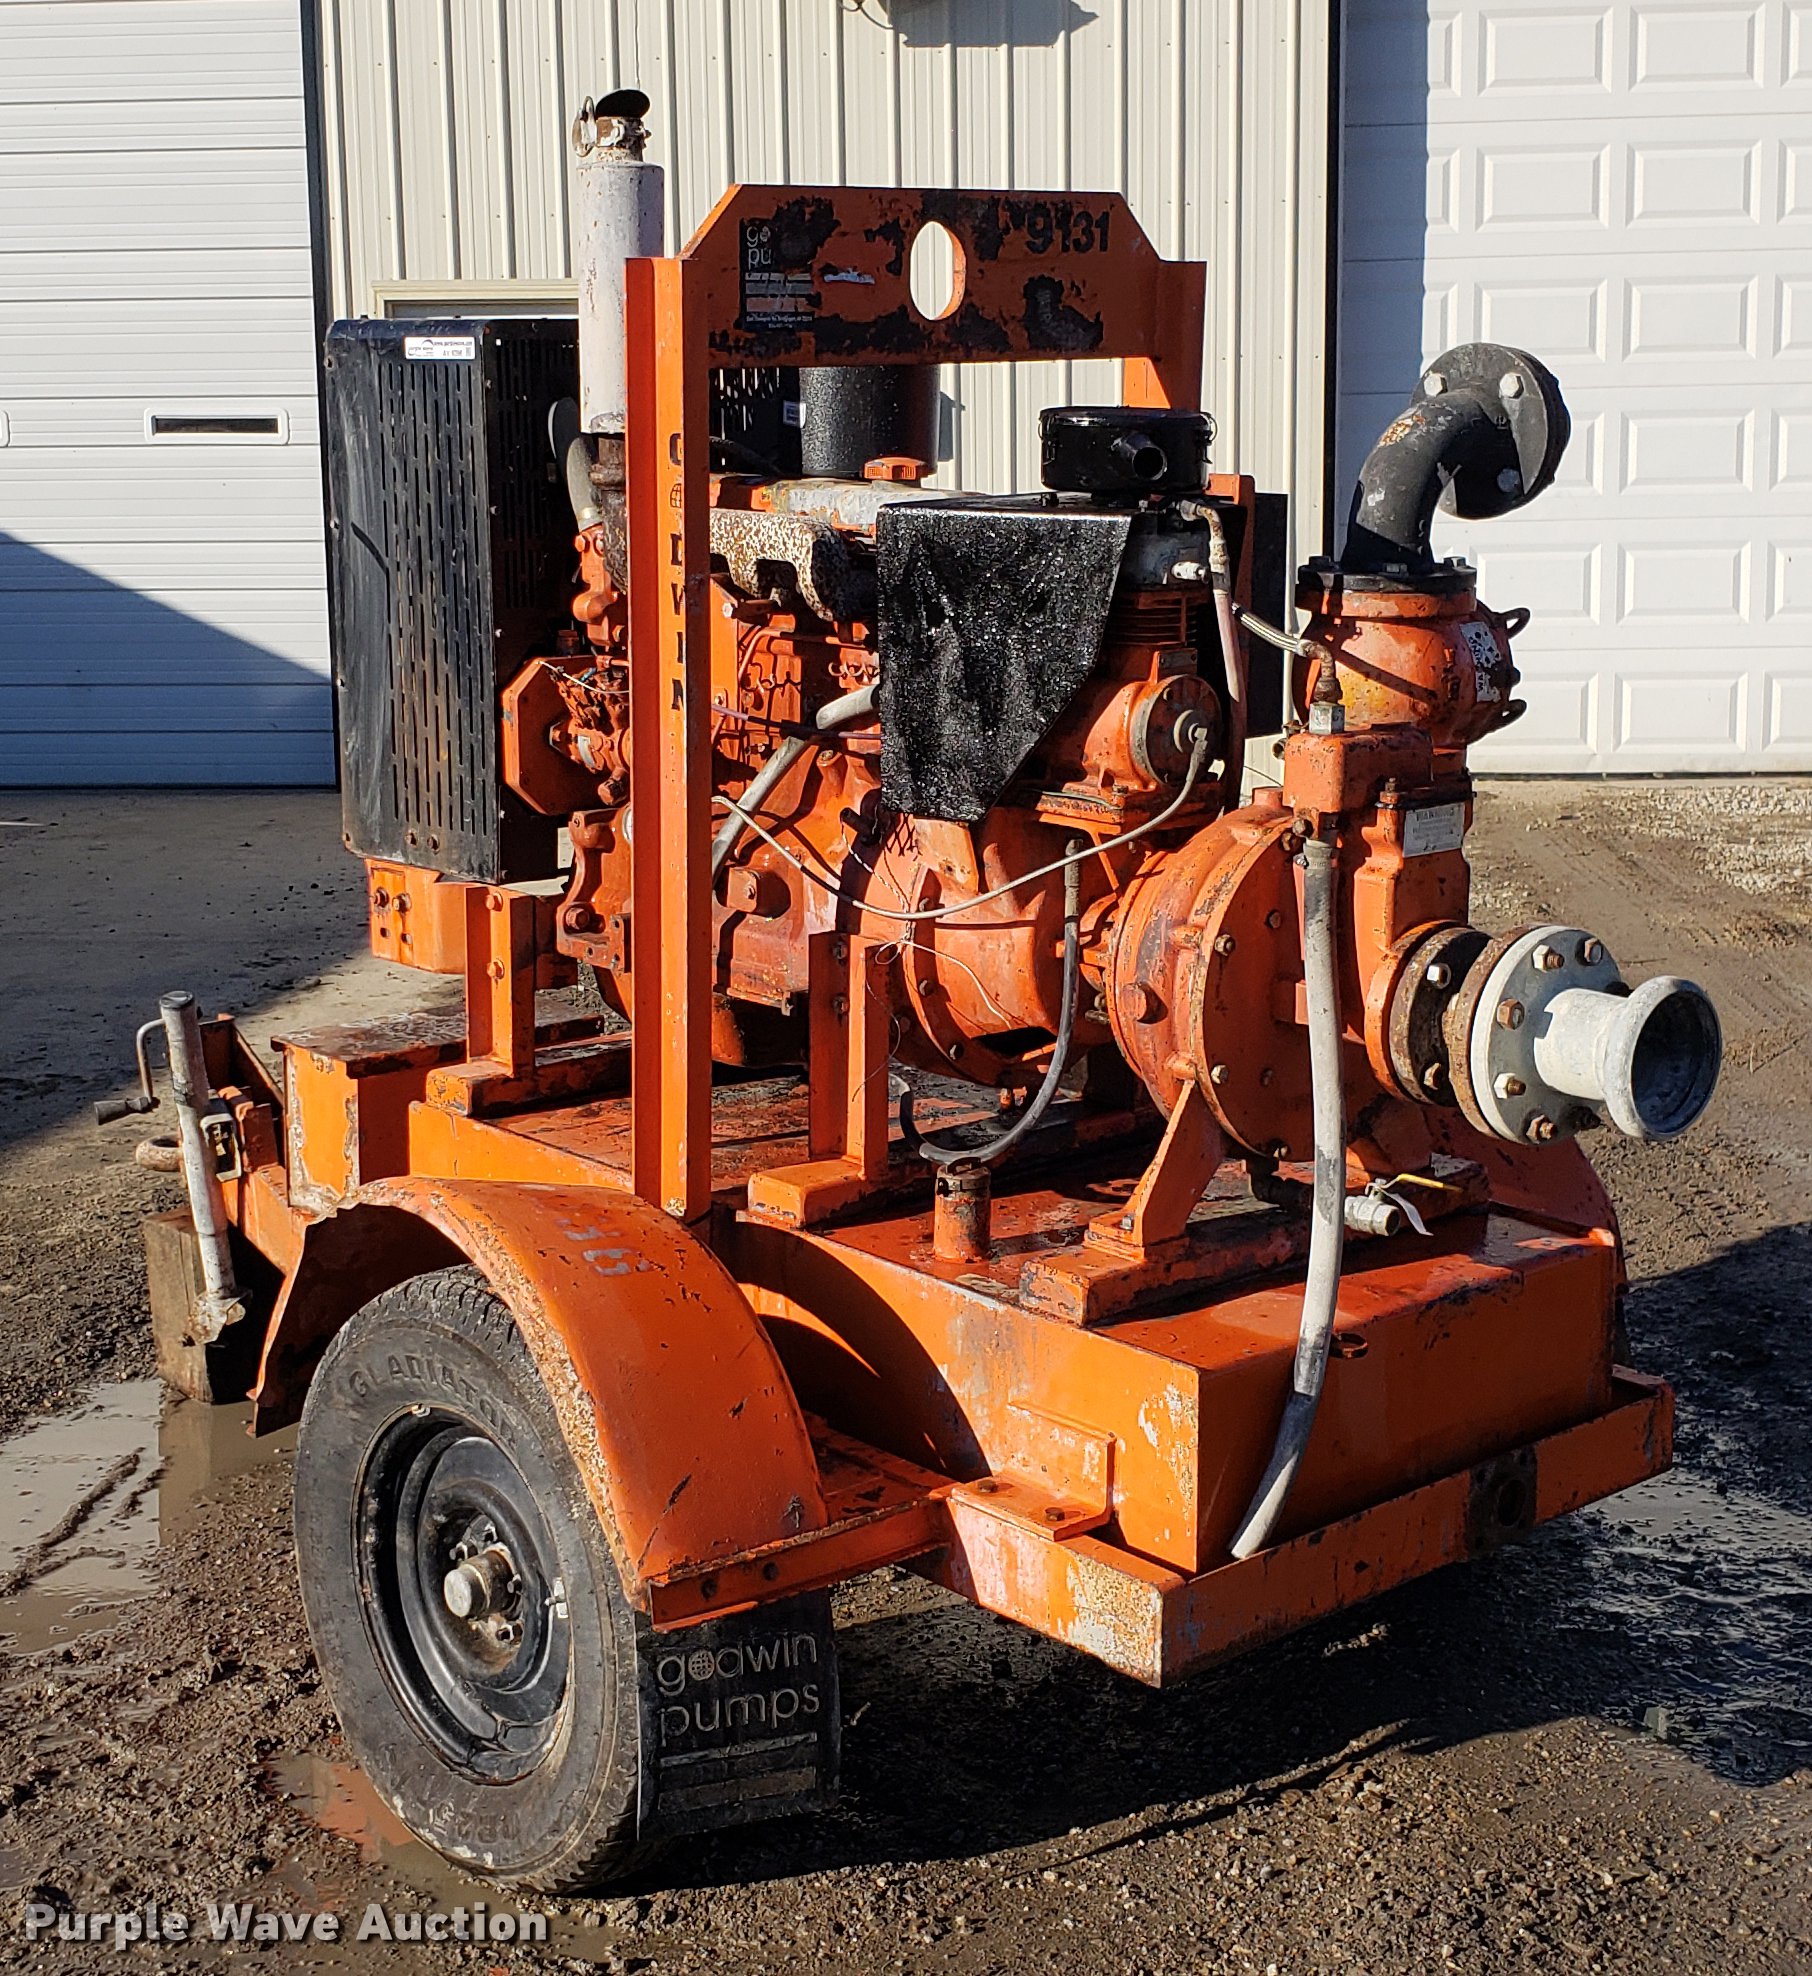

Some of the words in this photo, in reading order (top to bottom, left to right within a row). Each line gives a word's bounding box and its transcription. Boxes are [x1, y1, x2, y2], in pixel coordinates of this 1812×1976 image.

[348, 1352, 518, 1448] GLADIATOR
[656, 1632, 818, 1697] godwin
[658, 1683, 821, 1748] pumps
